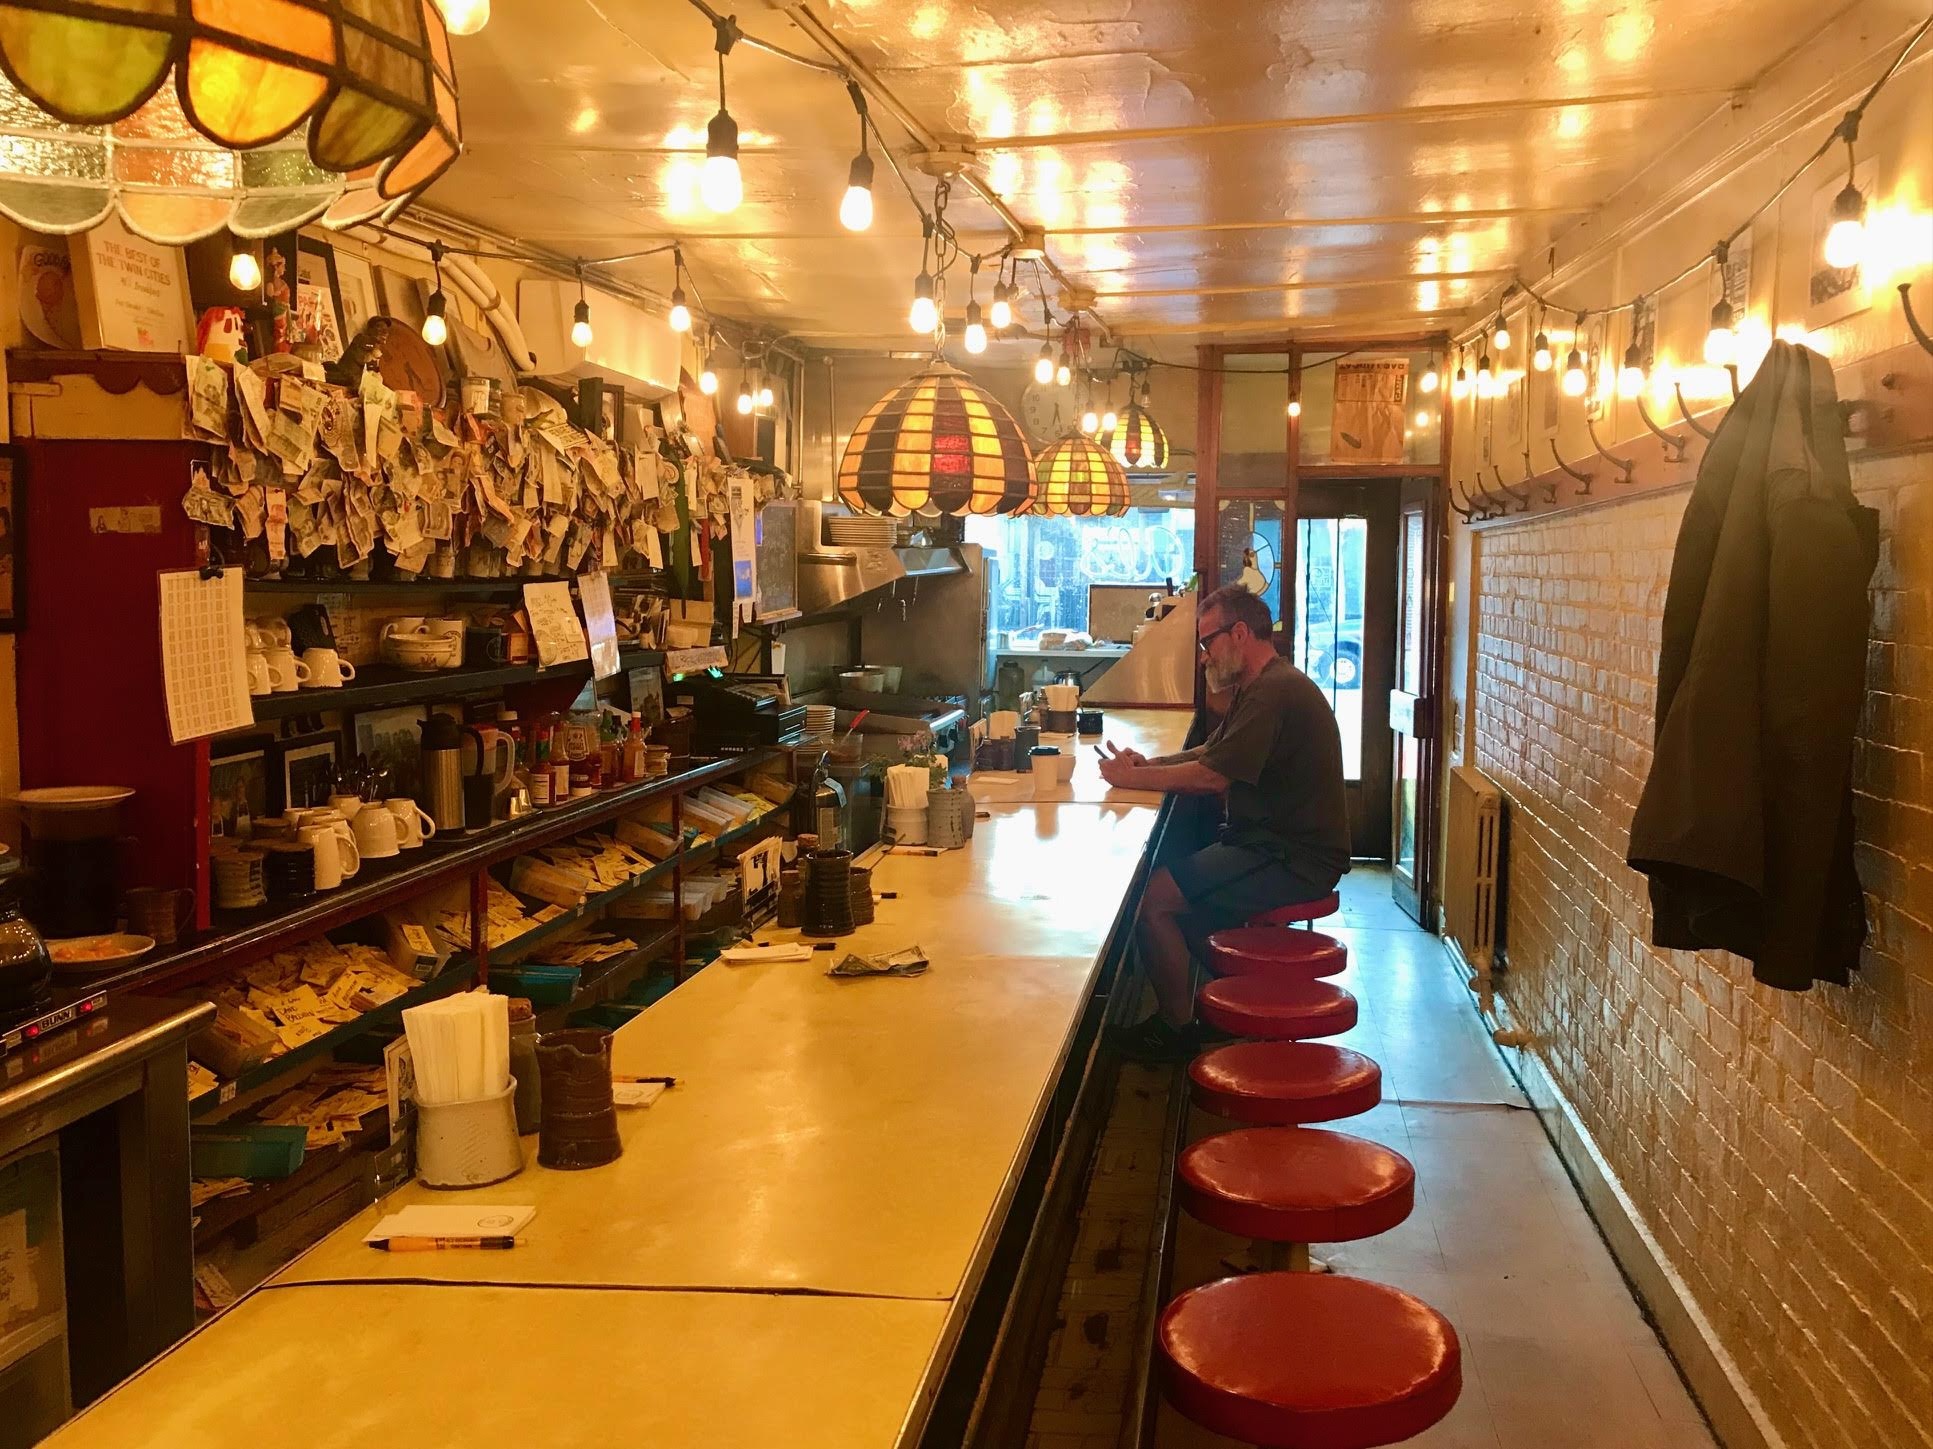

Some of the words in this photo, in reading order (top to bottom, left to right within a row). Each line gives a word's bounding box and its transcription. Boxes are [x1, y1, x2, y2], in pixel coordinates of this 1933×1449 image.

[104, 241, 121, 255] THE
[124, 247, 147, 263] BEST
[150, 256, 160, 268] OF
[96, 253, 115, 268] THE
[116, 259, 143, 277] TWIN
[144, 269, 171, 286] CITIES
[41, 1010, 71, 1029] BUNN
